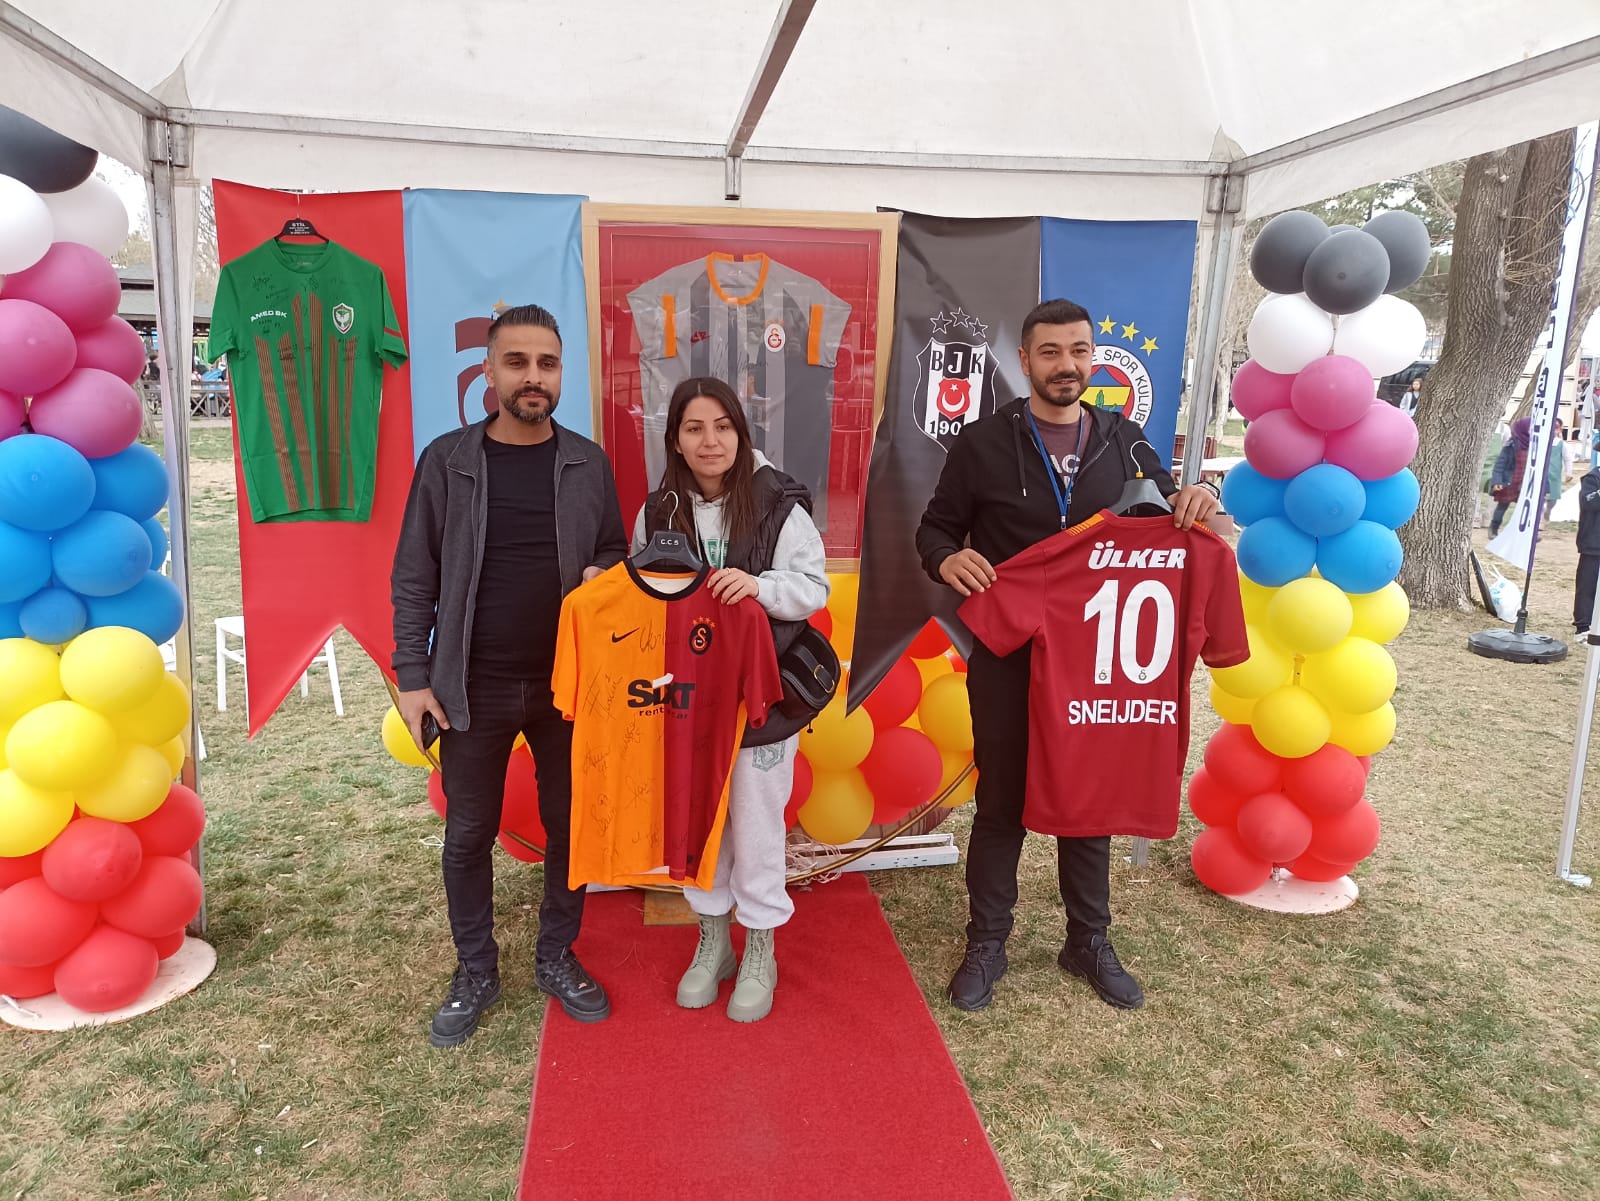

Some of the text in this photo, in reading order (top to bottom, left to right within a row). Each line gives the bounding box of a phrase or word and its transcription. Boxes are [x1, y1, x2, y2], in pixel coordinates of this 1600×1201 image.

[250, 310, 274, 322] AMED
[931, 350, 984, 374] BJK
[1103, 349, 1151, 422] SPOR KULÜB
[929, 420, 962, 436] 190
[1088, 540, 1187, 570] ÜLKER
[1083, 579, 1175, 685] 10
[639, 706, 664, 716] rent
[1068, 700, 1177, 725] SNEIJDER
